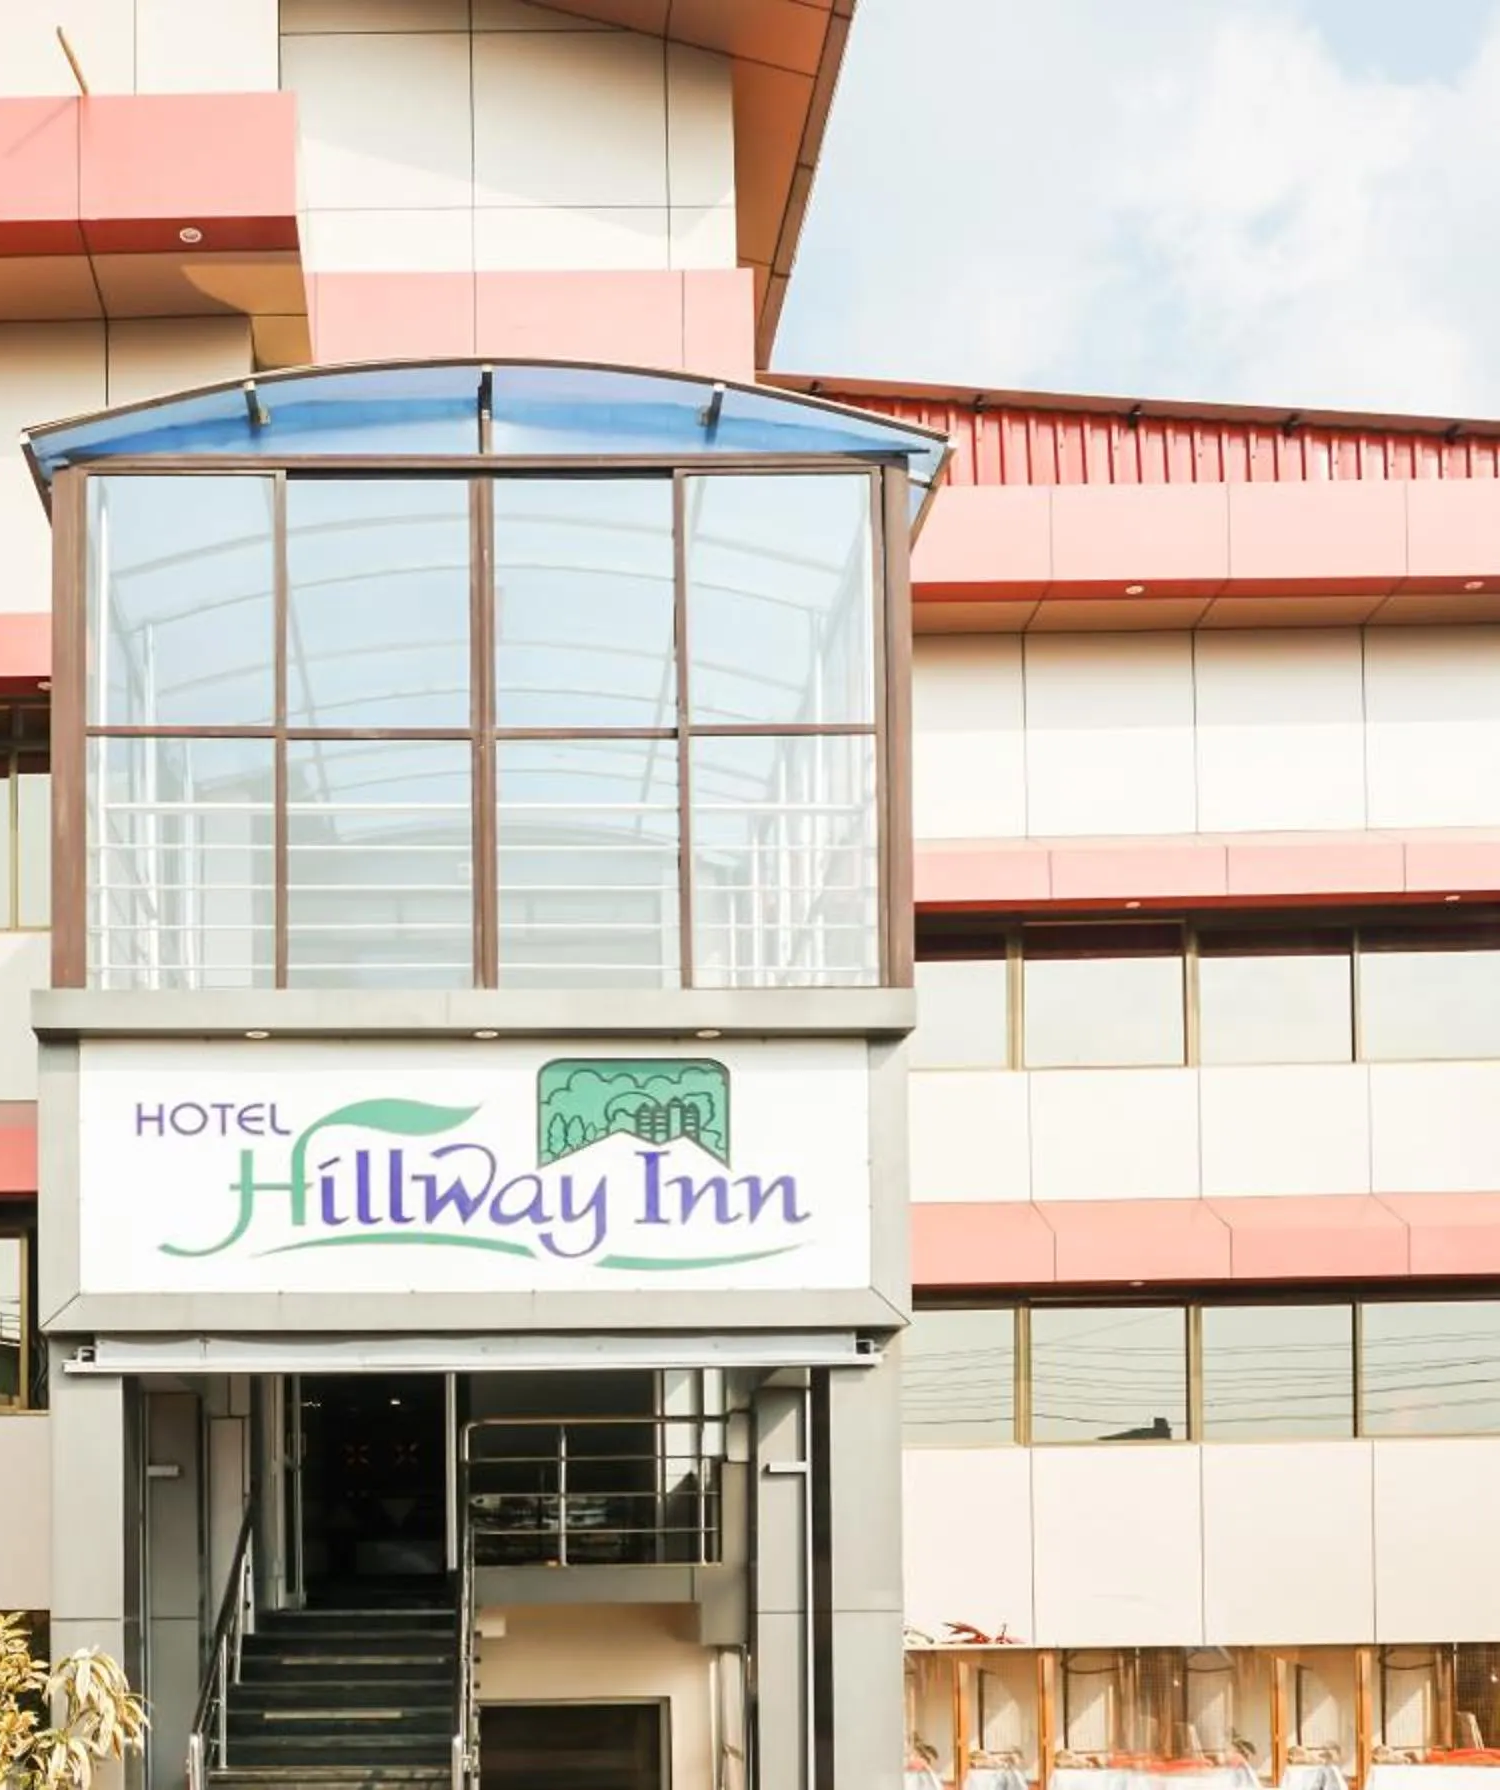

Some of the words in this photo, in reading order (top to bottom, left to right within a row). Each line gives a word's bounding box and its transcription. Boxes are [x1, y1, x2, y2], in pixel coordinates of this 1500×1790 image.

[134, 1102, 292, 1137] HOTEL
[156, 1097, 608, 1259] Hillway
[632, 1149, 812, 1226] Inn
